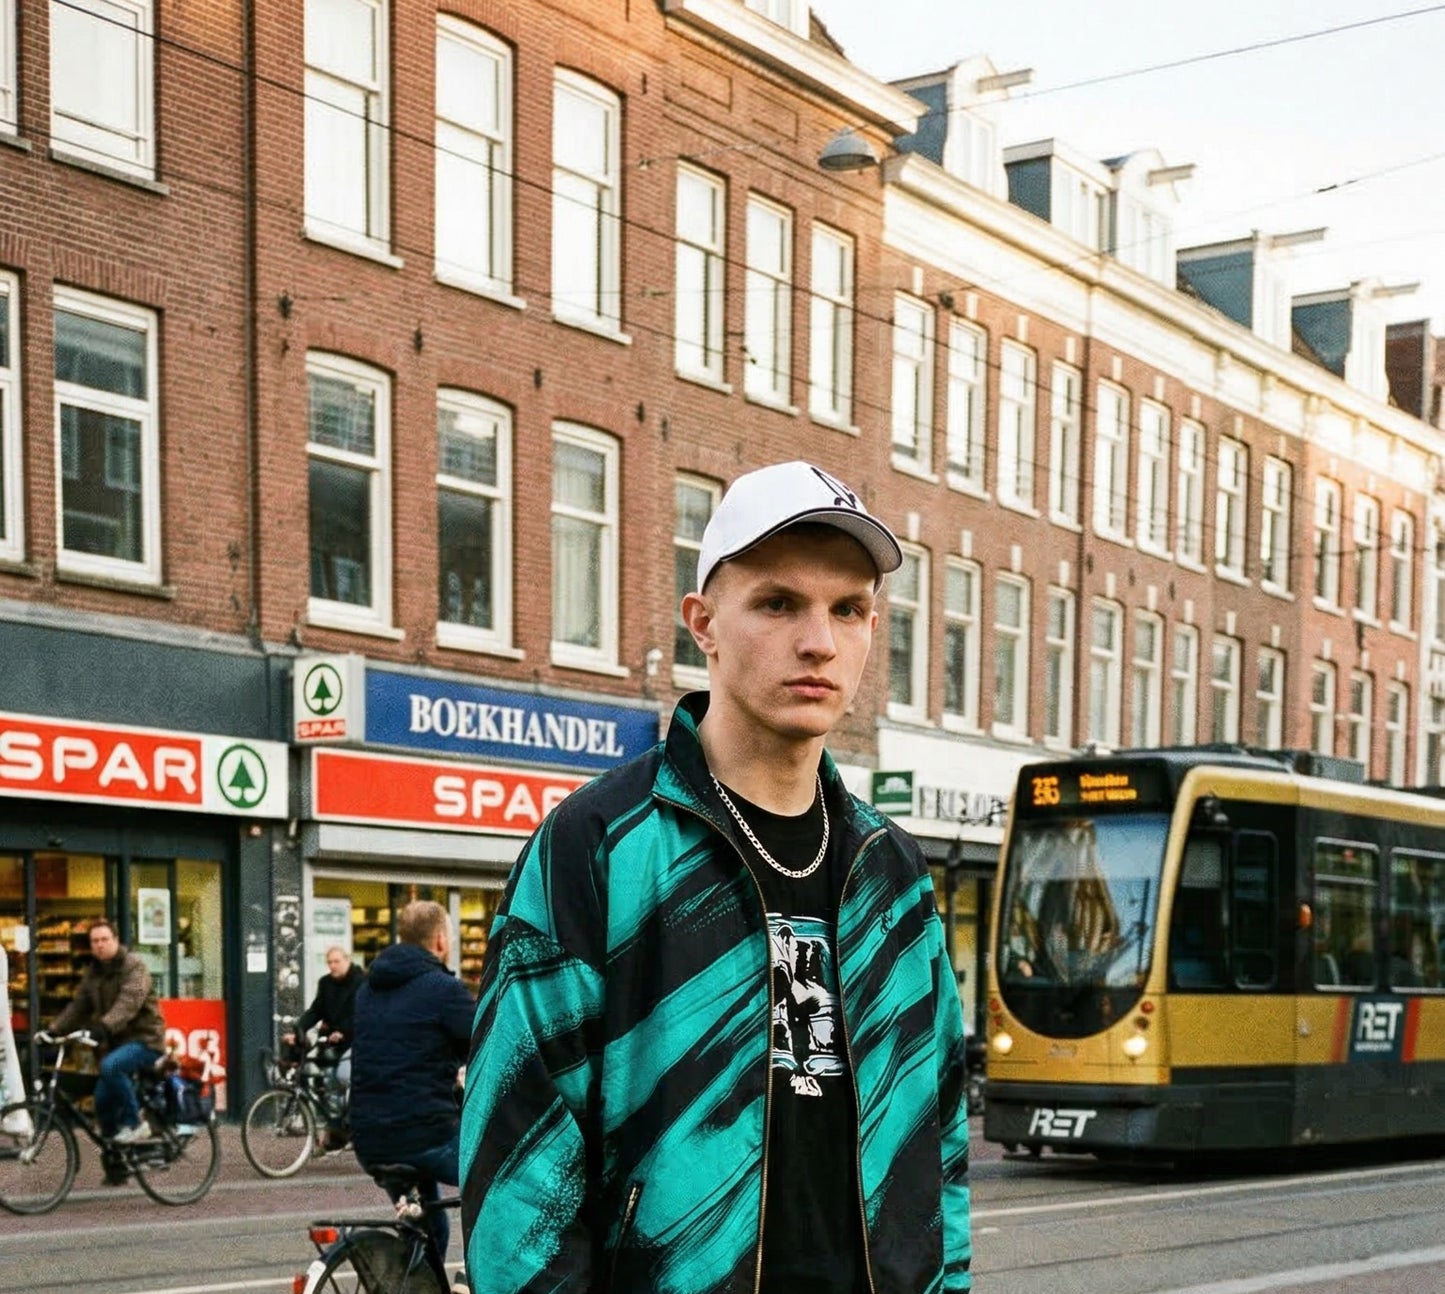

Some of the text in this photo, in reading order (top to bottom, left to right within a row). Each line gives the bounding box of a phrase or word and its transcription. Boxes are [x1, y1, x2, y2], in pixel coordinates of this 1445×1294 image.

[409, 694, 624, 757] BOEKHANDEL
[0, 730, 197, 794] SPAR
[1357, 1001, 1403, 1040] RET
[1028, 1108, 1097, 1138] RET
